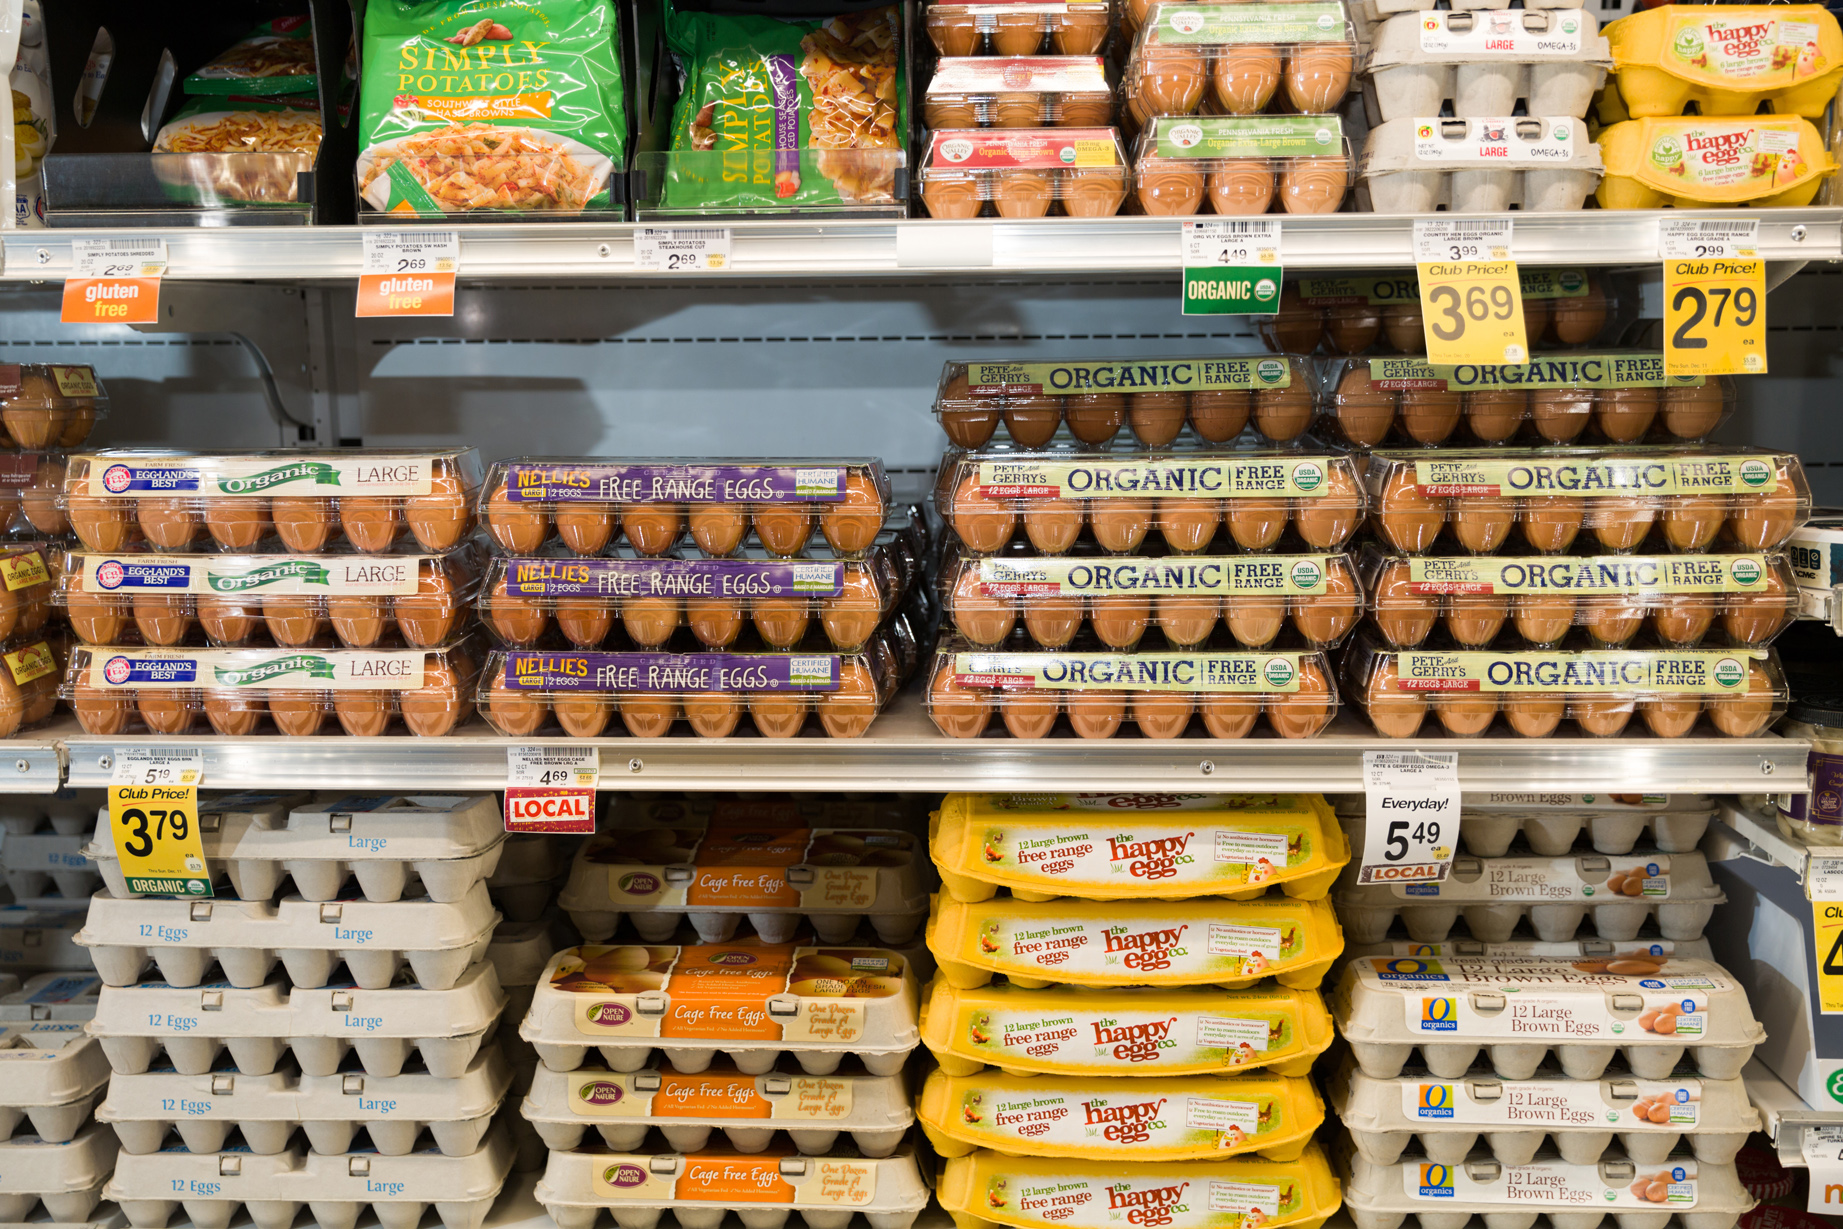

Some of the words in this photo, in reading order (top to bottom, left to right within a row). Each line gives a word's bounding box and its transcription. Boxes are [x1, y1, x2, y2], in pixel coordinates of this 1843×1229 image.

[399, 40, 551, 72] SIMPLY
[397, 68, 550, 93] POTATOES
[427, 98, 490, 109] SOUTHWT
[469, 108, 515, 118] BROWNS
[1218, 128, 1270, 136] PENNSYLVANIA
[1271, 127, 1294, 135] FRESH
[1691, 130, 1706, 138] the
[1208, 137, 1237, 149] Organic
[1238, 137, 1282, 150] Extra-Large
[1282, 137, 1306, 148] Brown
[1683, 129, 1755, 152] happy
[1479, 147, 1509, 157] LARGE
[1531, 149, 1570, 158] OMEGA-3s
[1702, 147, 1741, 166] egg
[1429, 264, 1464, 277] Club
[1466, 263, 1508, 276] Price!
[1676, 263, 1709, 275] Club
[1713, 262, 1757, 275] Price!
[85, 283, 139, 302] gluten
[380, 277, 434, 296] gluten
[1188, 280, 1251, 301] ORGANIC
[94, 301, 128, 317] free
[388, 294, 422, 310] free
[1050, 363, 1192, 390] ORGANIC
[226, 464, 319, 493] Organic
[357, 465, 420, 483] LARGE
[1067, 467, 1223, 492] ORGANIC
[1235, 465, 1285, 479] FREE
[151, 480, 178, 488] BEST
[1236, 479, 1285, 491] RANGE
[7, 569, 30, 581] ORGANIC
[350, 660, 412, 676] LARGE
[515, 657, 589, 677] NELLIE'S
[790, 659, 831, 667] CERTIFIED
[1411, 656, 1445, 667] PETE
[151, 670, 176, 680] BEST
[223, 656, 315, 685] Organic
[596, 664, 639, 689] FREE
[648, 665, 709, 689] RANGE
[720, 665, 767, 689] EGGS
[791, 666, 829, 675] HUMANE
[1412, 666, 1466, 677] GERRY'S
[1487, 661, 1643, 687] ORGANIC
[1655, 660, 1706, 674] FREE
[521, 677, 543, 686] LARGE
[545, 676, 554, 686] 12
[555, 676, 579, 686] EGGS
[1406, 679, 1417, 688] 12
[1656, 674, 1706, 686] RANGE
[118, 788, 149, 799] Club
[151, 788, 189, 799] Price!
[514, 799, 586, 818] LOCAL
[1381, 797, 1449, 812] Everyday!
[348, 834, 387, 853] Large
[1018, 841, 1029, 851] 12
[1029, 837, 1051, 849] large
[1052, 833, 1089, 846] brown
[1106, 831, 1195, 862] happy
[1115, 833, 1135, 844] the
[1017, 848, 1048, 865] free
[1050, 843, 1093, 860] range
[1040, 858, 1075, 875] eggs
[1129, 854, 1178, 880] egg
[1374, 865, 1437, 880] LOCAL
[132, 879, 185, 893] ORGANIC
[139, 924, 153, 938] 12
[158, 925, 188, 941] Eggs
[335, 926, 373, 945] Large
[602, 1007, 625, 1016] OPEN
[674, 1005, 706, 1026] Cage
[709, 1005, 733, 1020] Free
[737, 1005, 765, 1027] Eggs
[1512, 1005, 1528, 1019] 12
[1532, 1005, 1573, 1021] Large
[1422, 1019, 1457, 1031] organics
[1511, 1019, 1560, 1033] Brown
[1564, 1020, 1600, 1036] Eggs
[690, 1165, 720, 1186] Cage
[723, 1166, 748, 1181] Free
[751, 1167, 779, 1187] Eggs
[821, 1163, 839, 1175] One
[841, 1165, 868, 1176] Dozen
[822, 1175, 848, 1188] Grade
[821, 1186, 847, 1200] Large
[848, 1186, 868, 1201] Eggs
